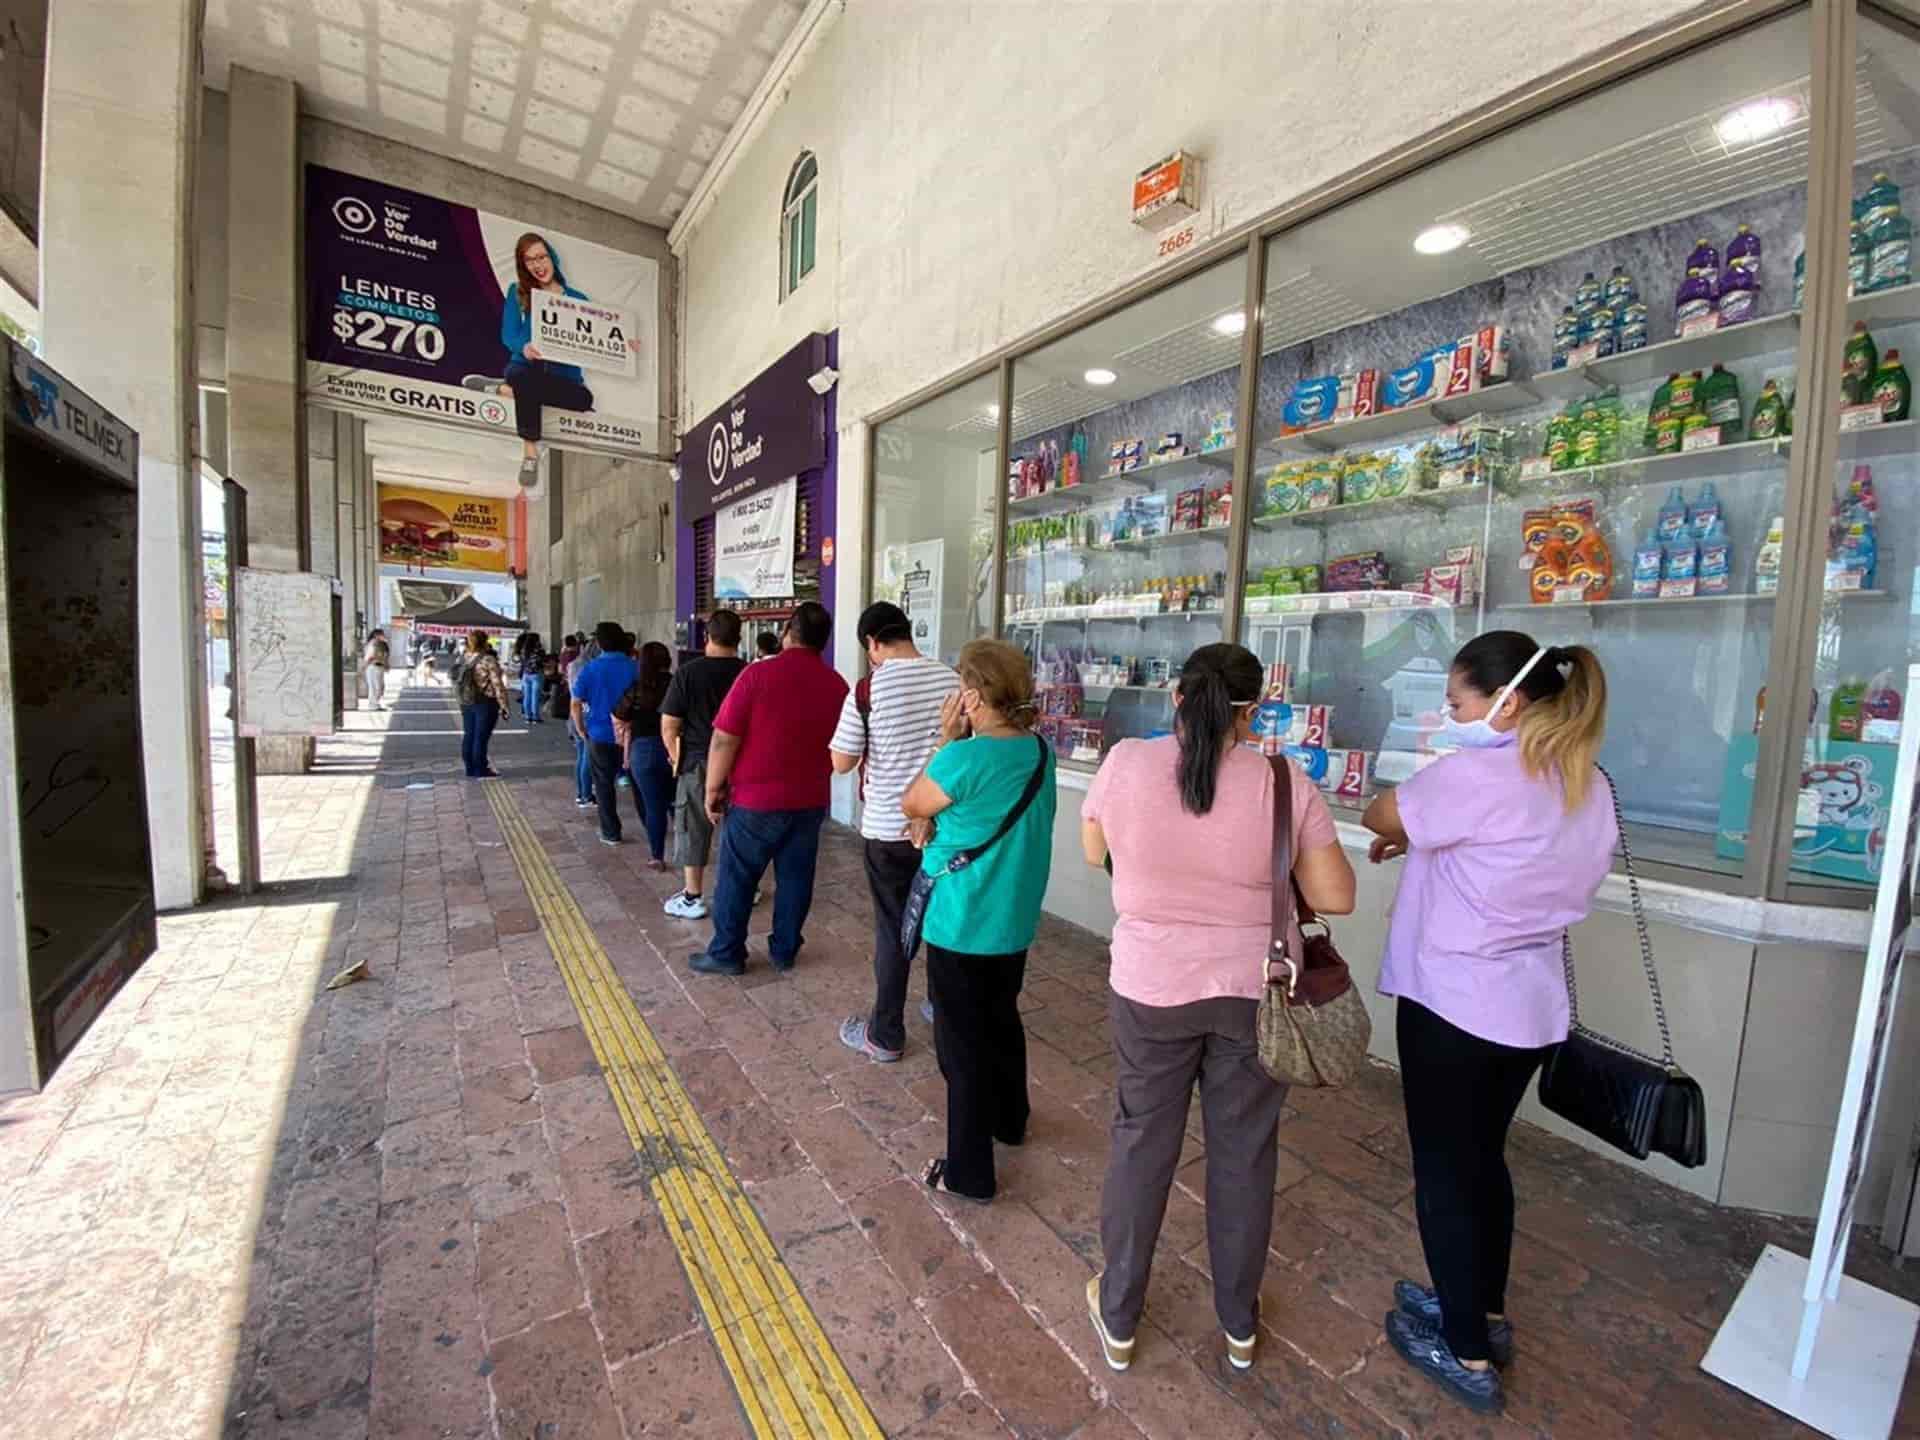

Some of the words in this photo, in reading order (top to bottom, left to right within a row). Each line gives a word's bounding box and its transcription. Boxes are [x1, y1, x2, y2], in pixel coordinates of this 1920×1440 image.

[385, 206, 410, 221] Ver
[385, 217, 404, 231] De
[385, 228, 437, 250] Verdad
[341, 275, 436, 311] LENTES
[343, 294, 435, 322] COMPLETOS
[333, 310, 446, 361] $270
[541, 325, 596, 346] DISCULPA
[328, 375, 386, 393] Examen
[390, 388, 475, 416] GRATIS
[64, 400, 127, 462] TELMEX
[1345, 772, 1361, 792] 2
